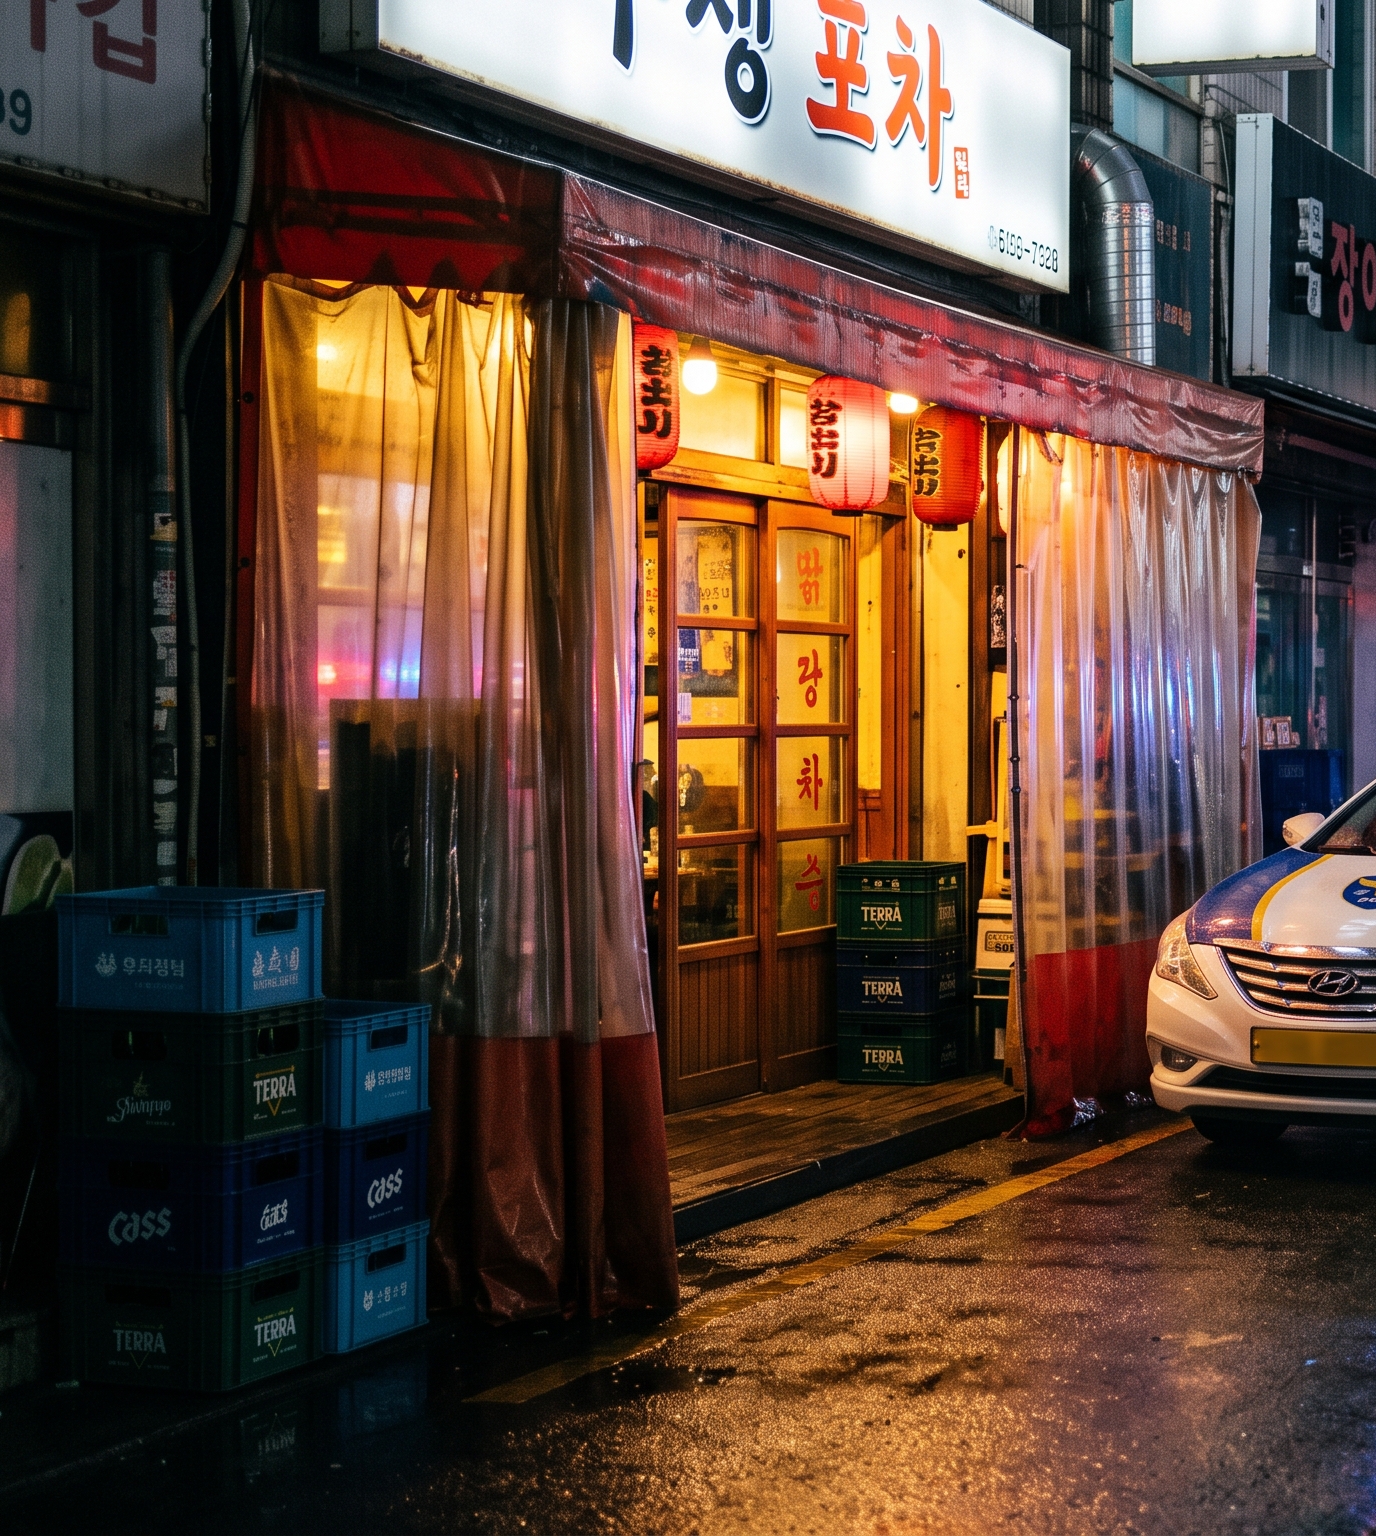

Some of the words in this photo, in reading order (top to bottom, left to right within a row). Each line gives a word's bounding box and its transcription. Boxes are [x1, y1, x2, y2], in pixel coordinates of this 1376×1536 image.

[805, 0, 953, 187] 포차
[860, 906, 903, 923] TERRA
[861, 980, 904, 997] TERRA
[253, 1072, 297, 1106] TERRA
[112, 1328, 167, 1355] TERRA
[254, 1314, 297, 1347] TERRA
